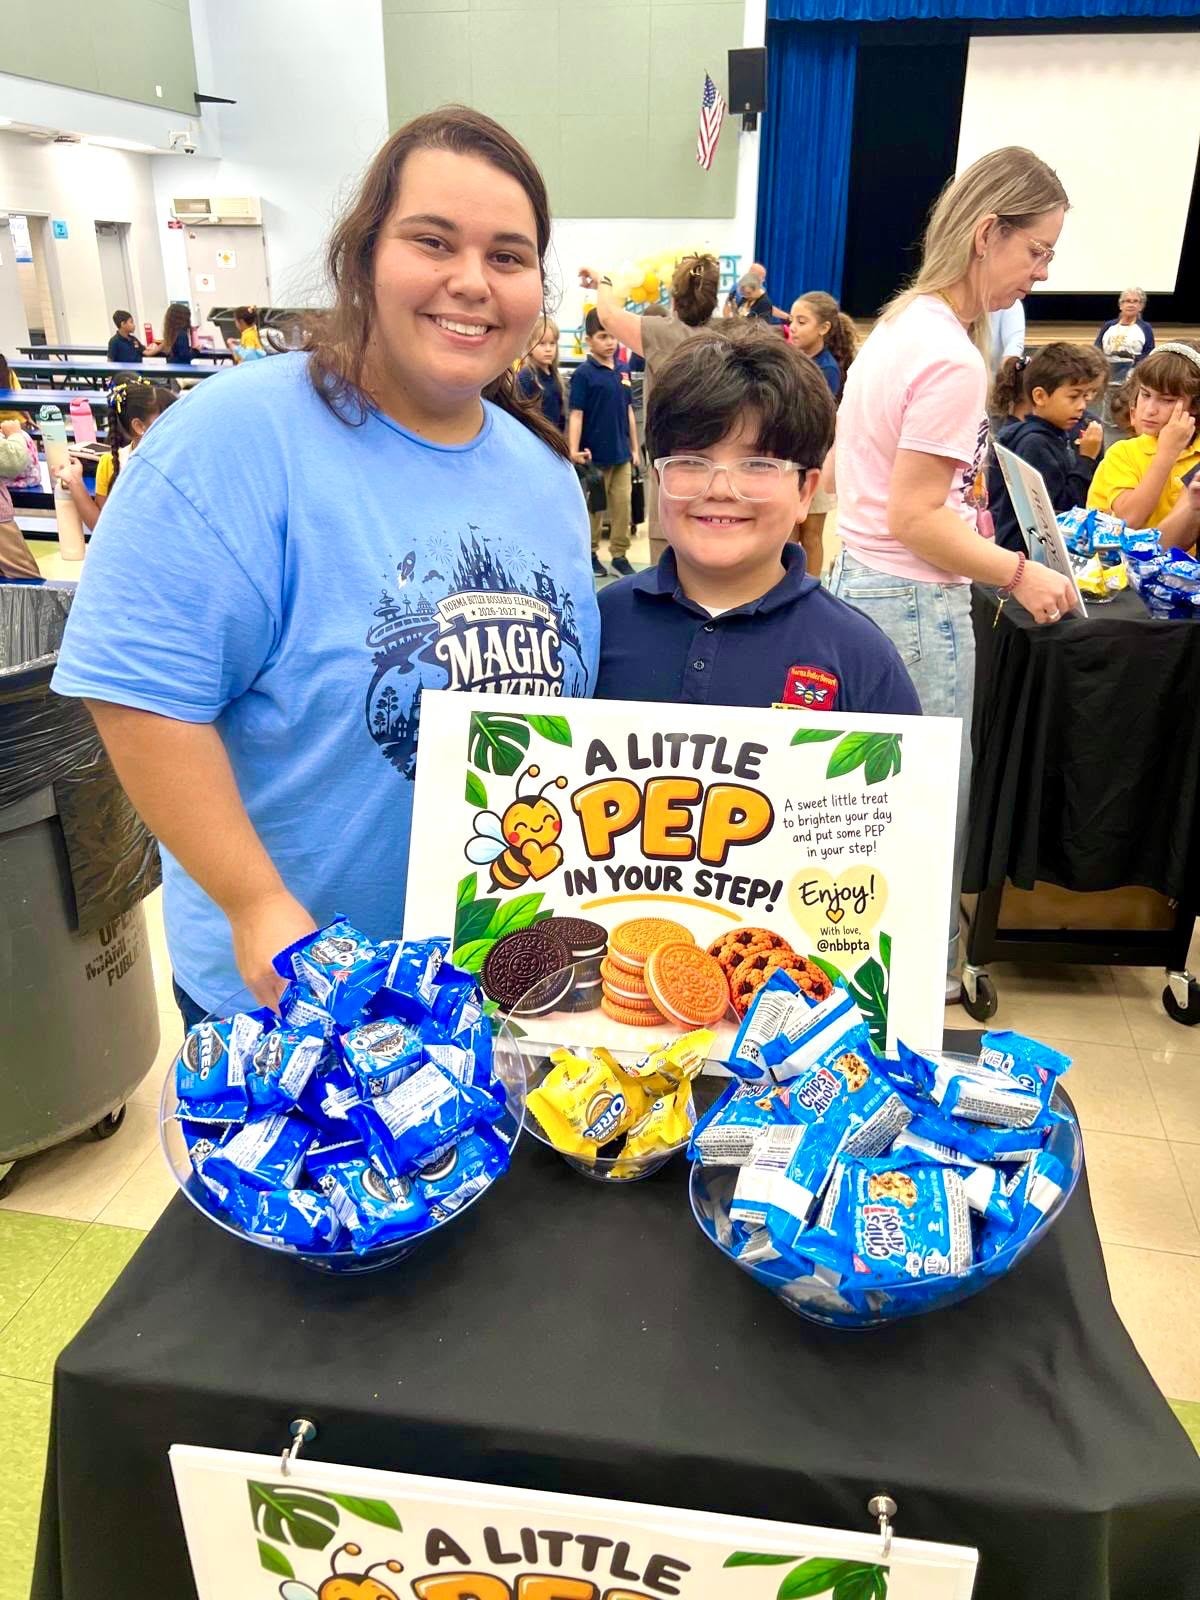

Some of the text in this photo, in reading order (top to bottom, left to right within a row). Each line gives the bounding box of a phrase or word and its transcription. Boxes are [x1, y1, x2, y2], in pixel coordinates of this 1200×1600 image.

[442, 594, 548, 615] NORMA BUTLER BOSSARD ELEMENTARY
[435, 624, 562, 691] MAGIC
[585, 732, 768, 780] A LITTLE
[785, 792, 888, 812] A sweet little treat
[570, 776, 775, 868] PEP
[783, 808, 892, 829] to brighten your day
[793, 824, 885, 844] and put some PEP
[807, 840, 877, 860] in your step!
[564, 864, 783, 912] IN YOUR STEP!
[798, 874, 875, 914] Enjoy!
[820, 925, 861, 936] With love,
[817, 938, 870, 954] @nbbpta
[798, 1073, 827, 1109] Chips
[425, 1528, 472, 1566] A
[483, 1526, 692, 1595] LITTLE
